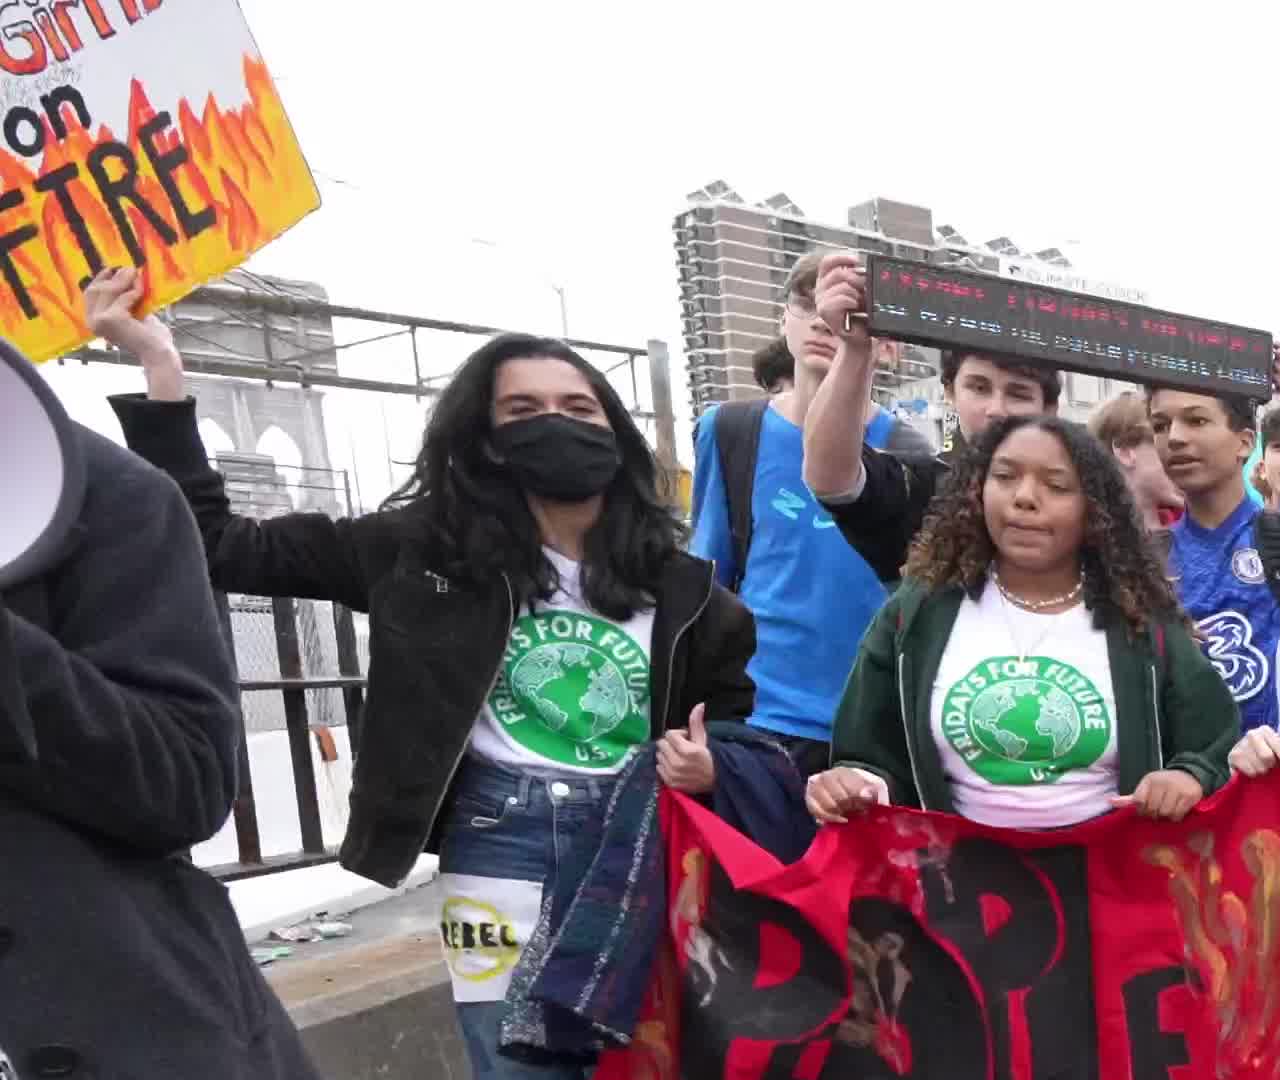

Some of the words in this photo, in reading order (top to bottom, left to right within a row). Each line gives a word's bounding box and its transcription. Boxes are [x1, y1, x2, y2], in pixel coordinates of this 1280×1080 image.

[3, 85, 91, 157] on
[496, 627, 532, 725] FRIYS
[534, 615, 593, 641] FOR
[946, 671, 987, 761] FRIDAYS
[987, 660, 1040, 681] FOR
[1043, 664, 1106, 729] FUTURE
